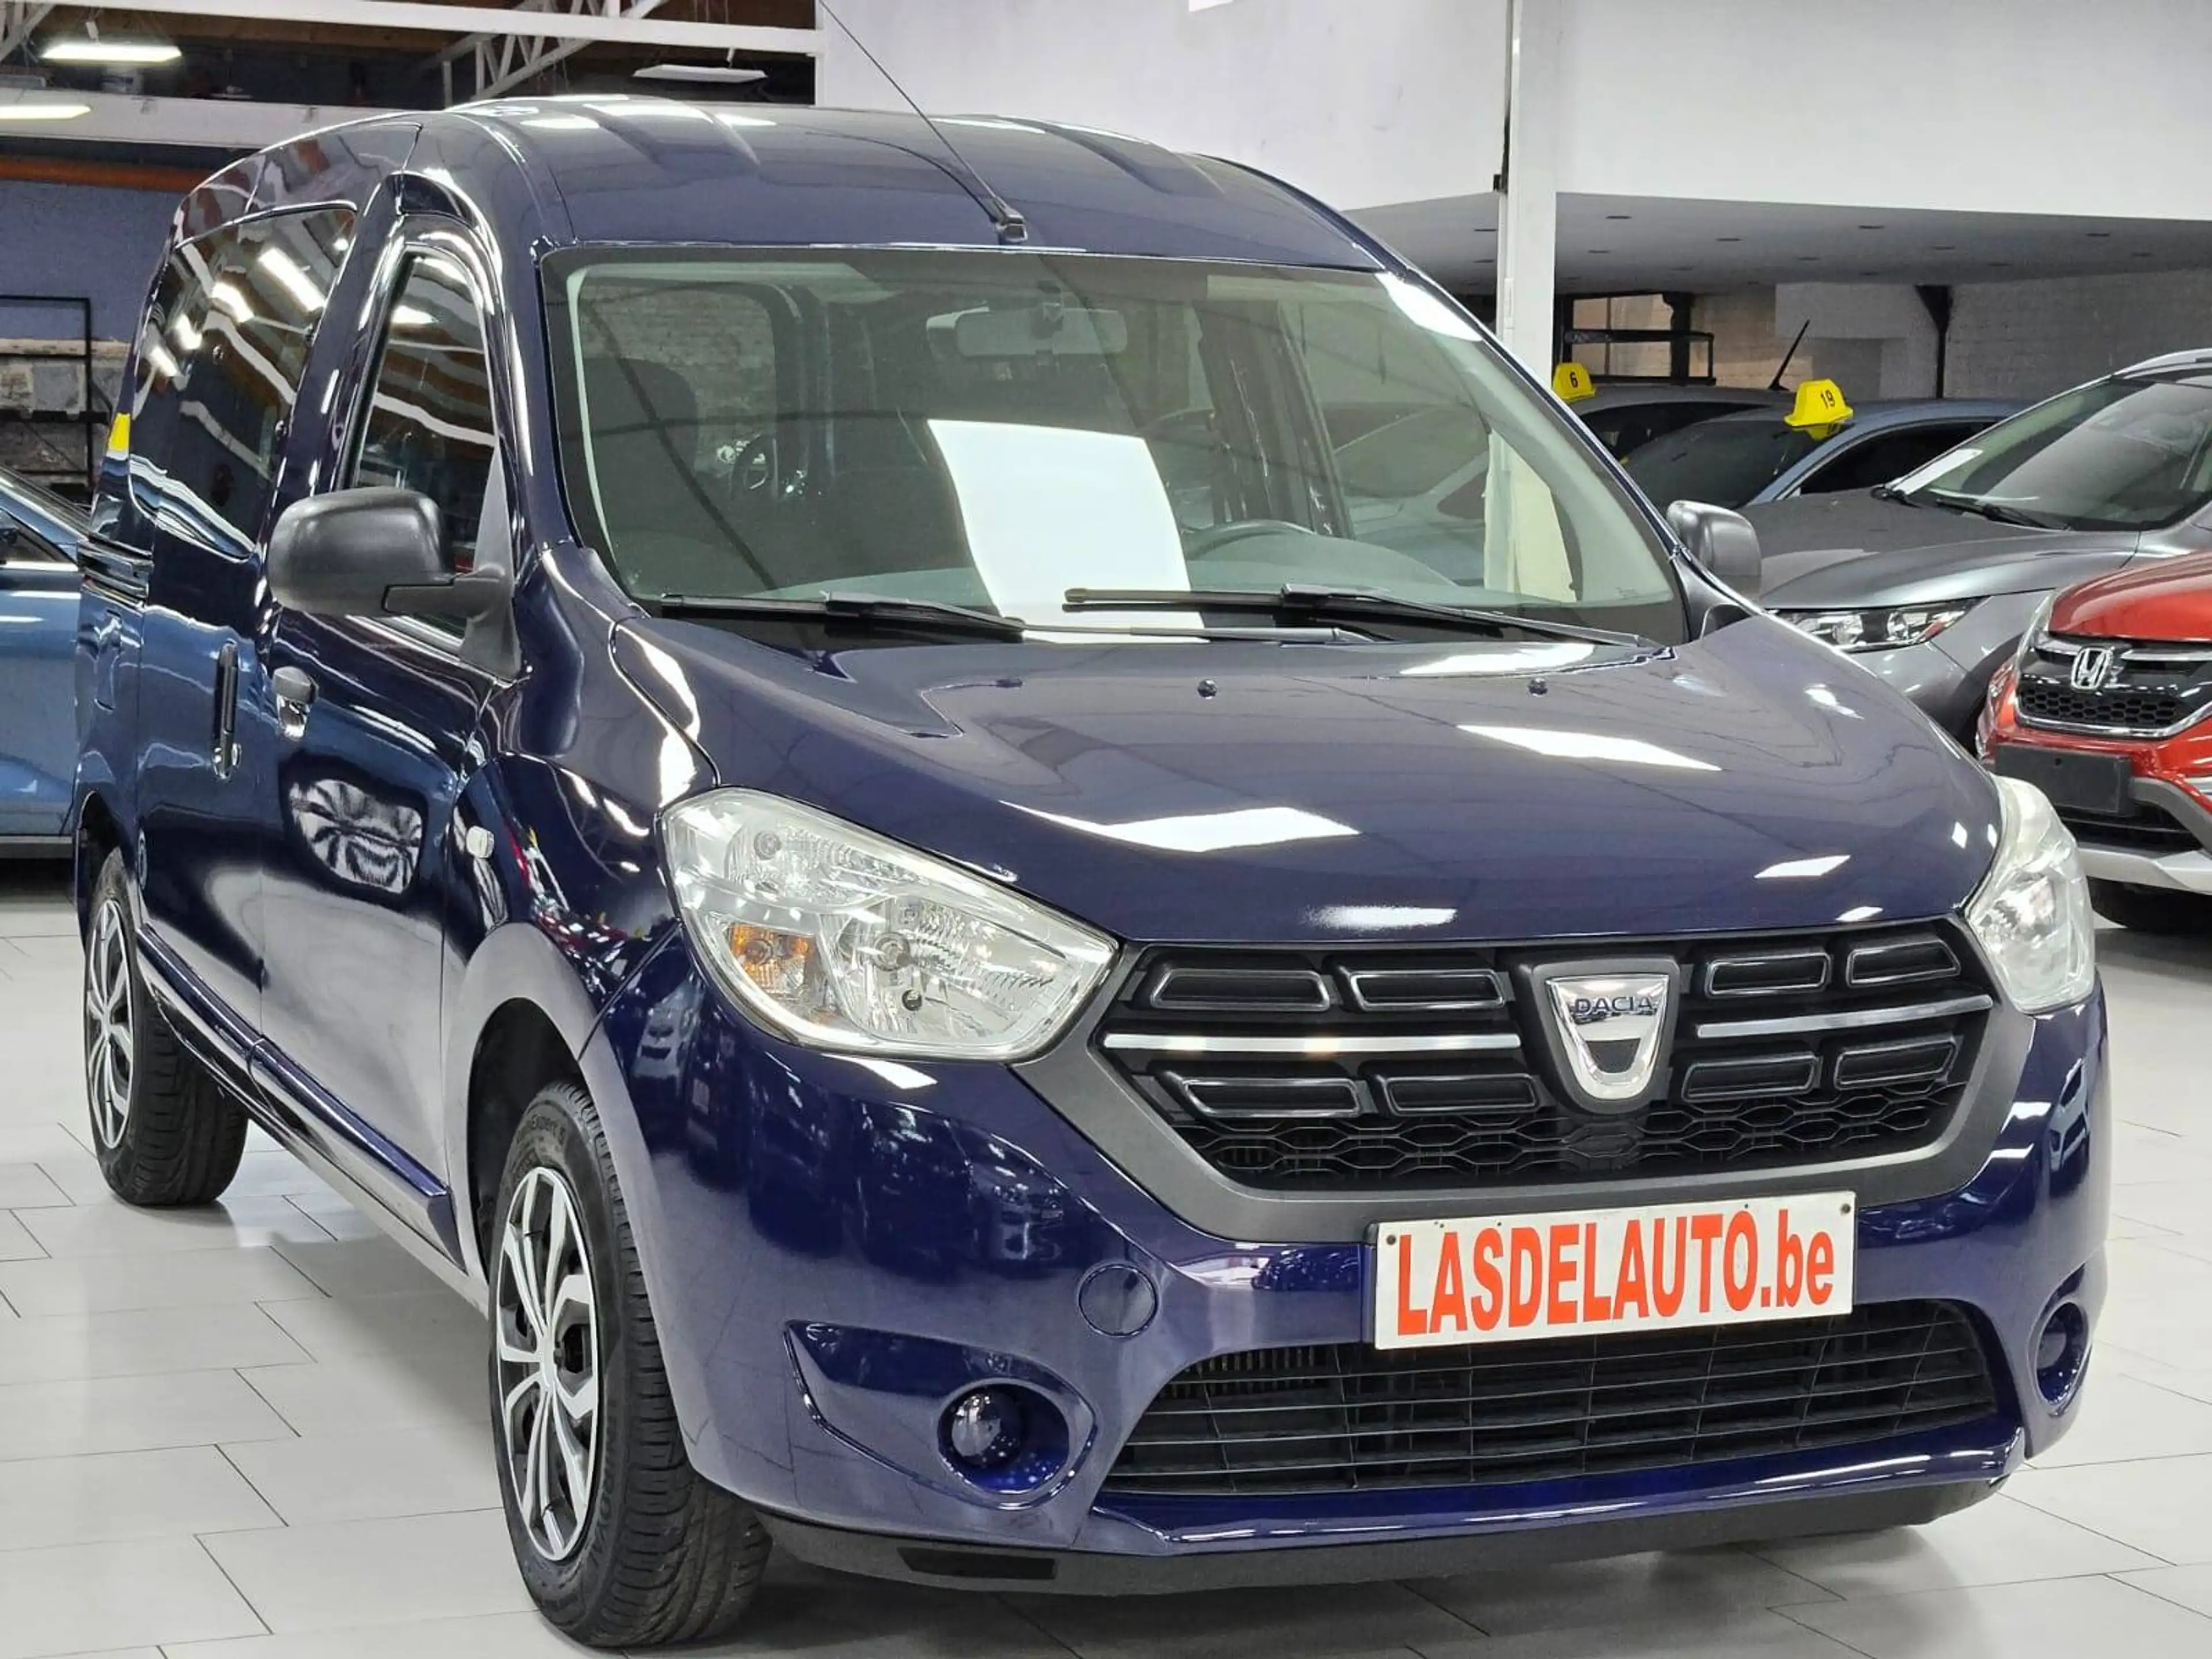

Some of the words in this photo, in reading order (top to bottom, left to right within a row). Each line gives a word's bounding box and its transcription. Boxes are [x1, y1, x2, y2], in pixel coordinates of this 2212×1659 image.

[1569, 372, 1578, 388] 6
[1820, 390, 1835, 409] 19
[1574, 996, 1653, 1014] DACIA
[1397, 1209, 1834, 1335] LASDELAUTO.be
